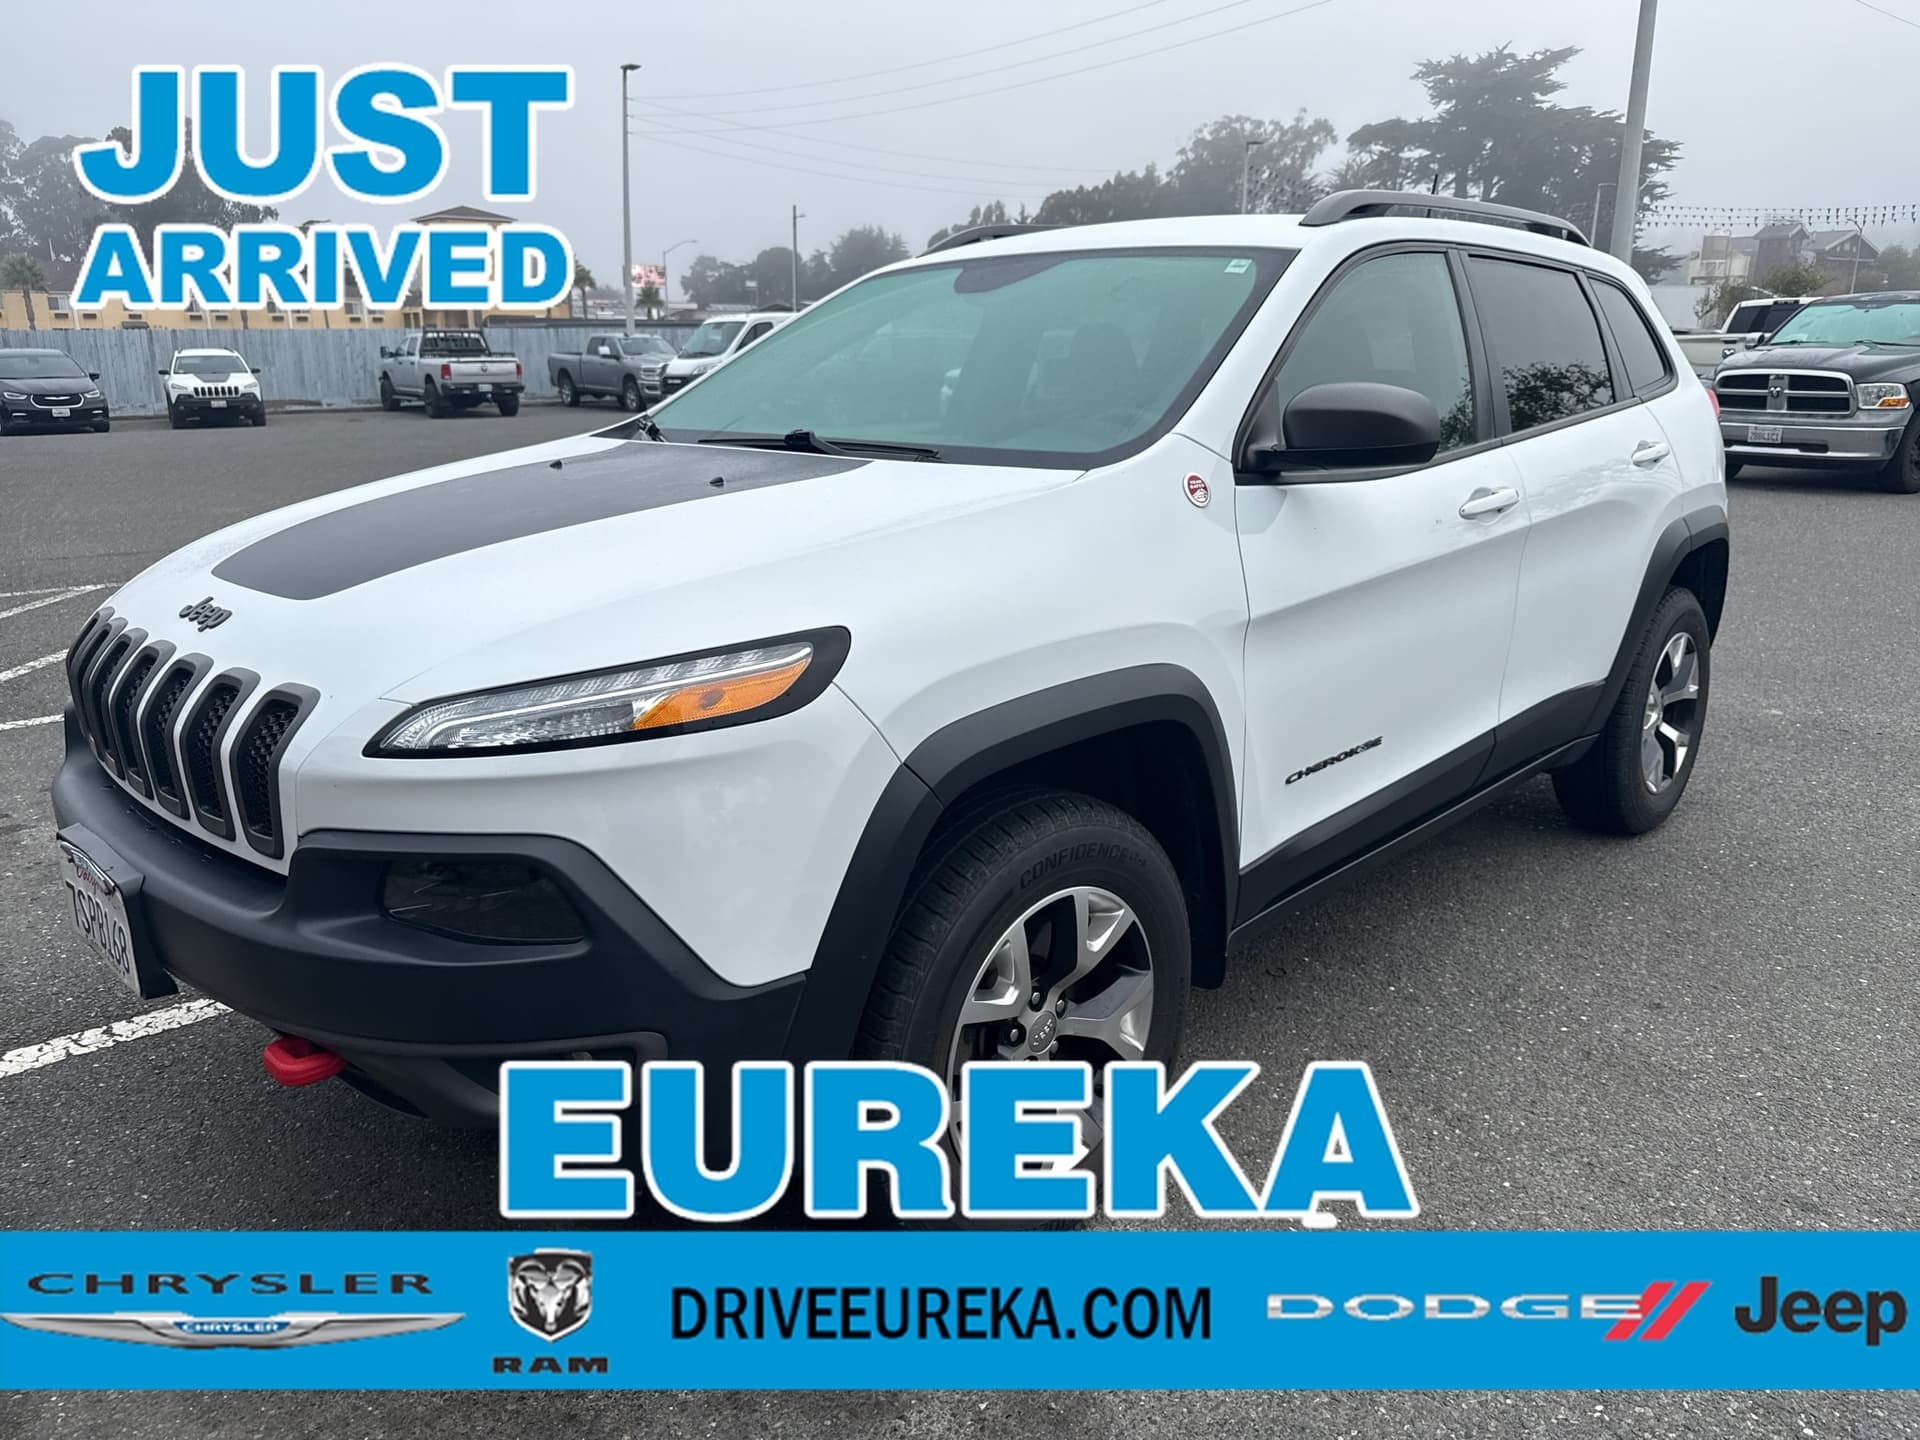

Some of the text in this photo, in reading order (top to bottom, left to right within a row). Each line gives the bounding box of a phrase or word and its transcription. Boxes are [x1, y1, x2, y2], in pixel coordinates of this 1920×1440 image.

[179, 596, 232, 632] Jeep
[1285, 736, 1382, 784] CHEROKEE
[66, 880, 130, 974] 7SPB168
